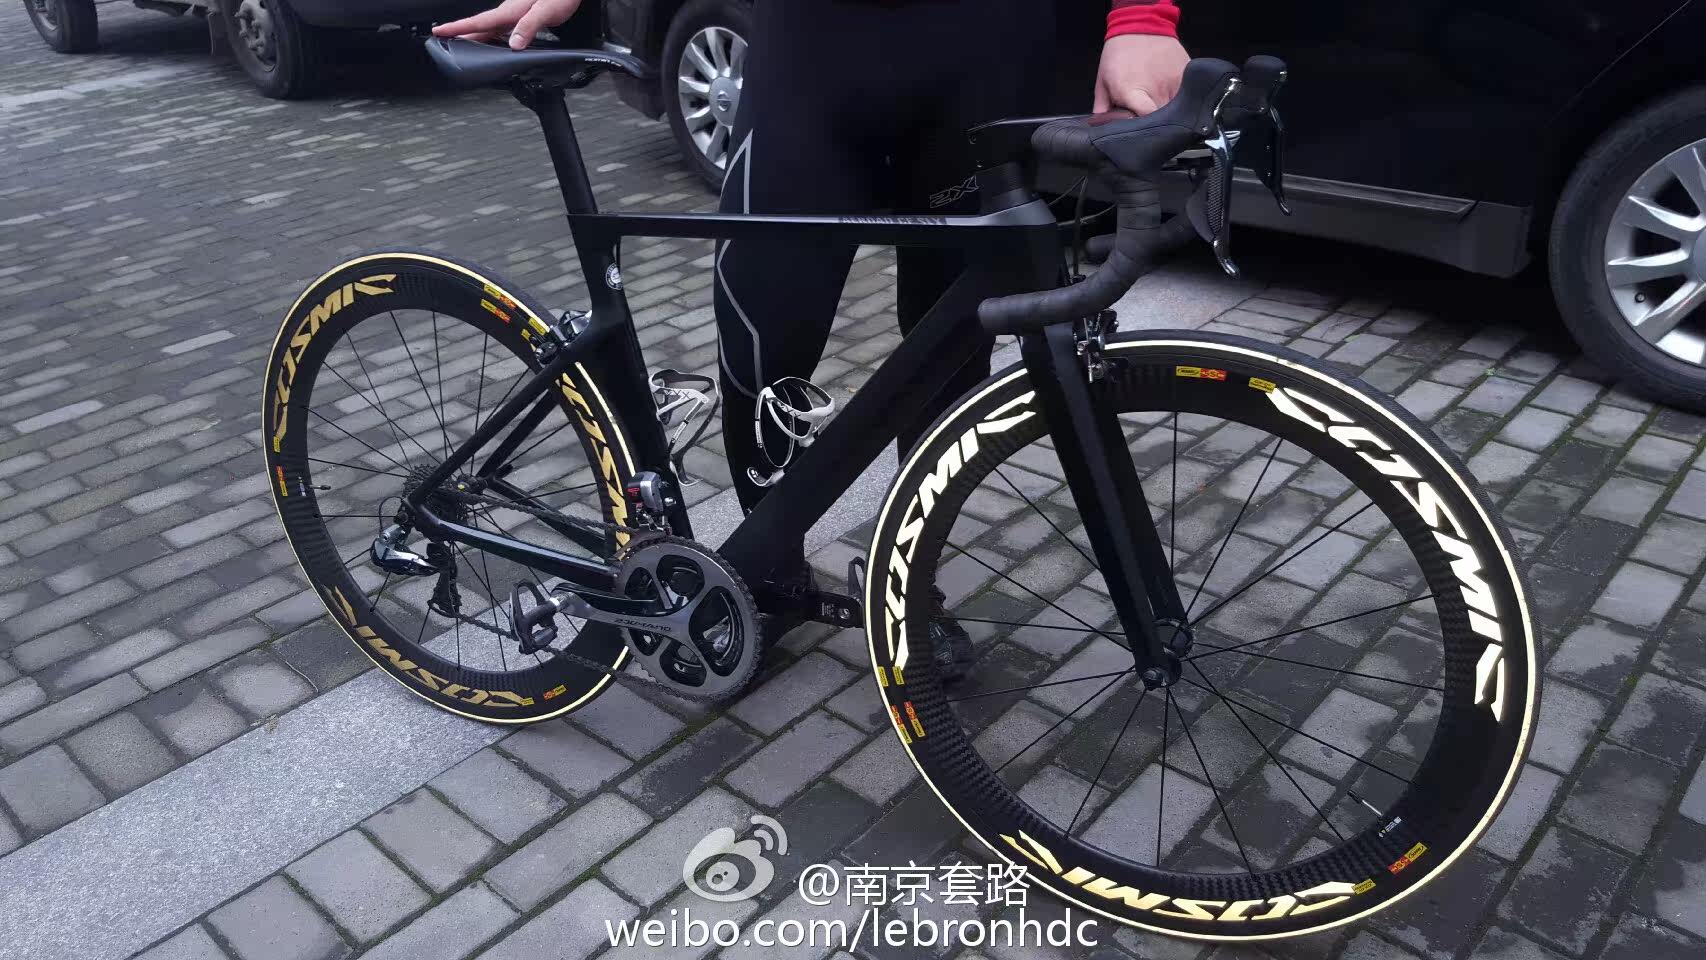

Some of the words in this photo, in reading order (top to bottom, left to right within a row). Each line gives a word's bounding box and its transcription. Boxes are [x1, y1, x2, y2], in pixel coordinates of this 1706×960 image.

[273, 273, 397, 441] COSMIC
[885, 390, 1037, 671] COSMIC
[1265, 387, 1505, 722] COSMIC
[328, 586, 532, 707] COSMIC
[1000, 830, 1355, 921] COSMIC
